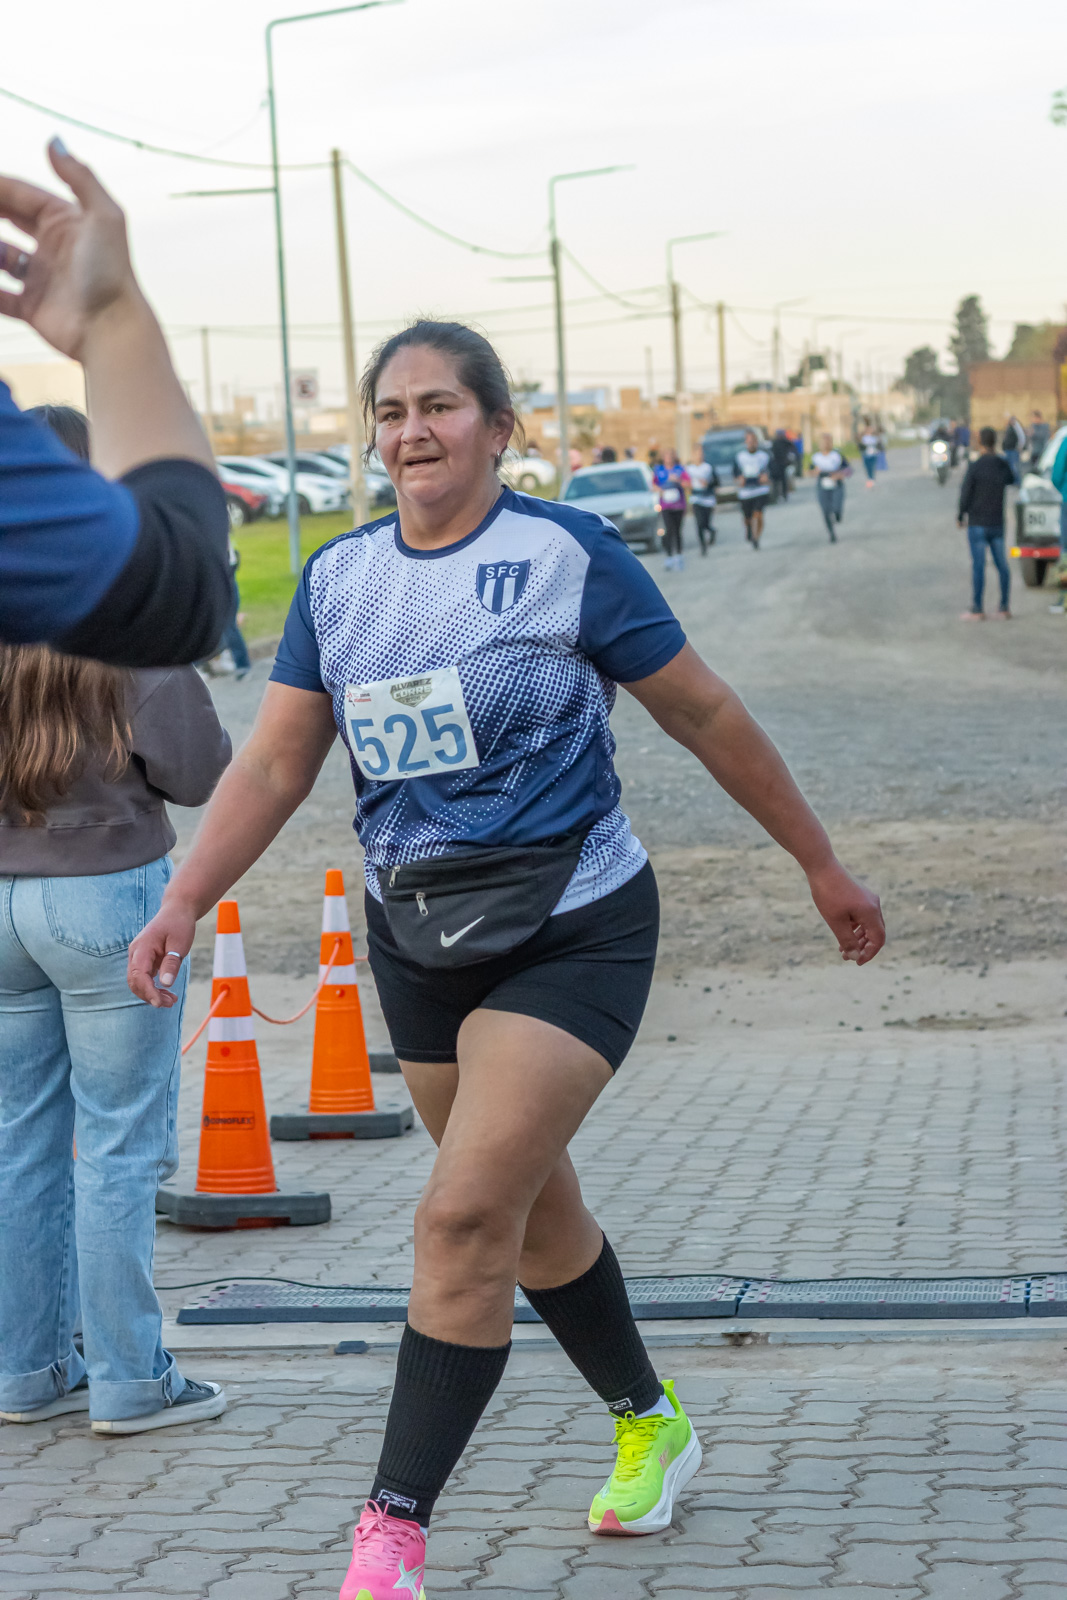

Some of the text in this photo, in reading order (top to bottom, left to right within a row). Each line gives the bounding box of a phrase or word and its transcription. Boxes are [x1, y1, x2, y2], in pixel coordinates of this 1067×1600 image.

[485, 565, 520, 579] SFC
[390, 678, 432, 692] ALVAREZ
[393, 685, 432, 699] CORRE
[350, 703, 468, 776] 525
